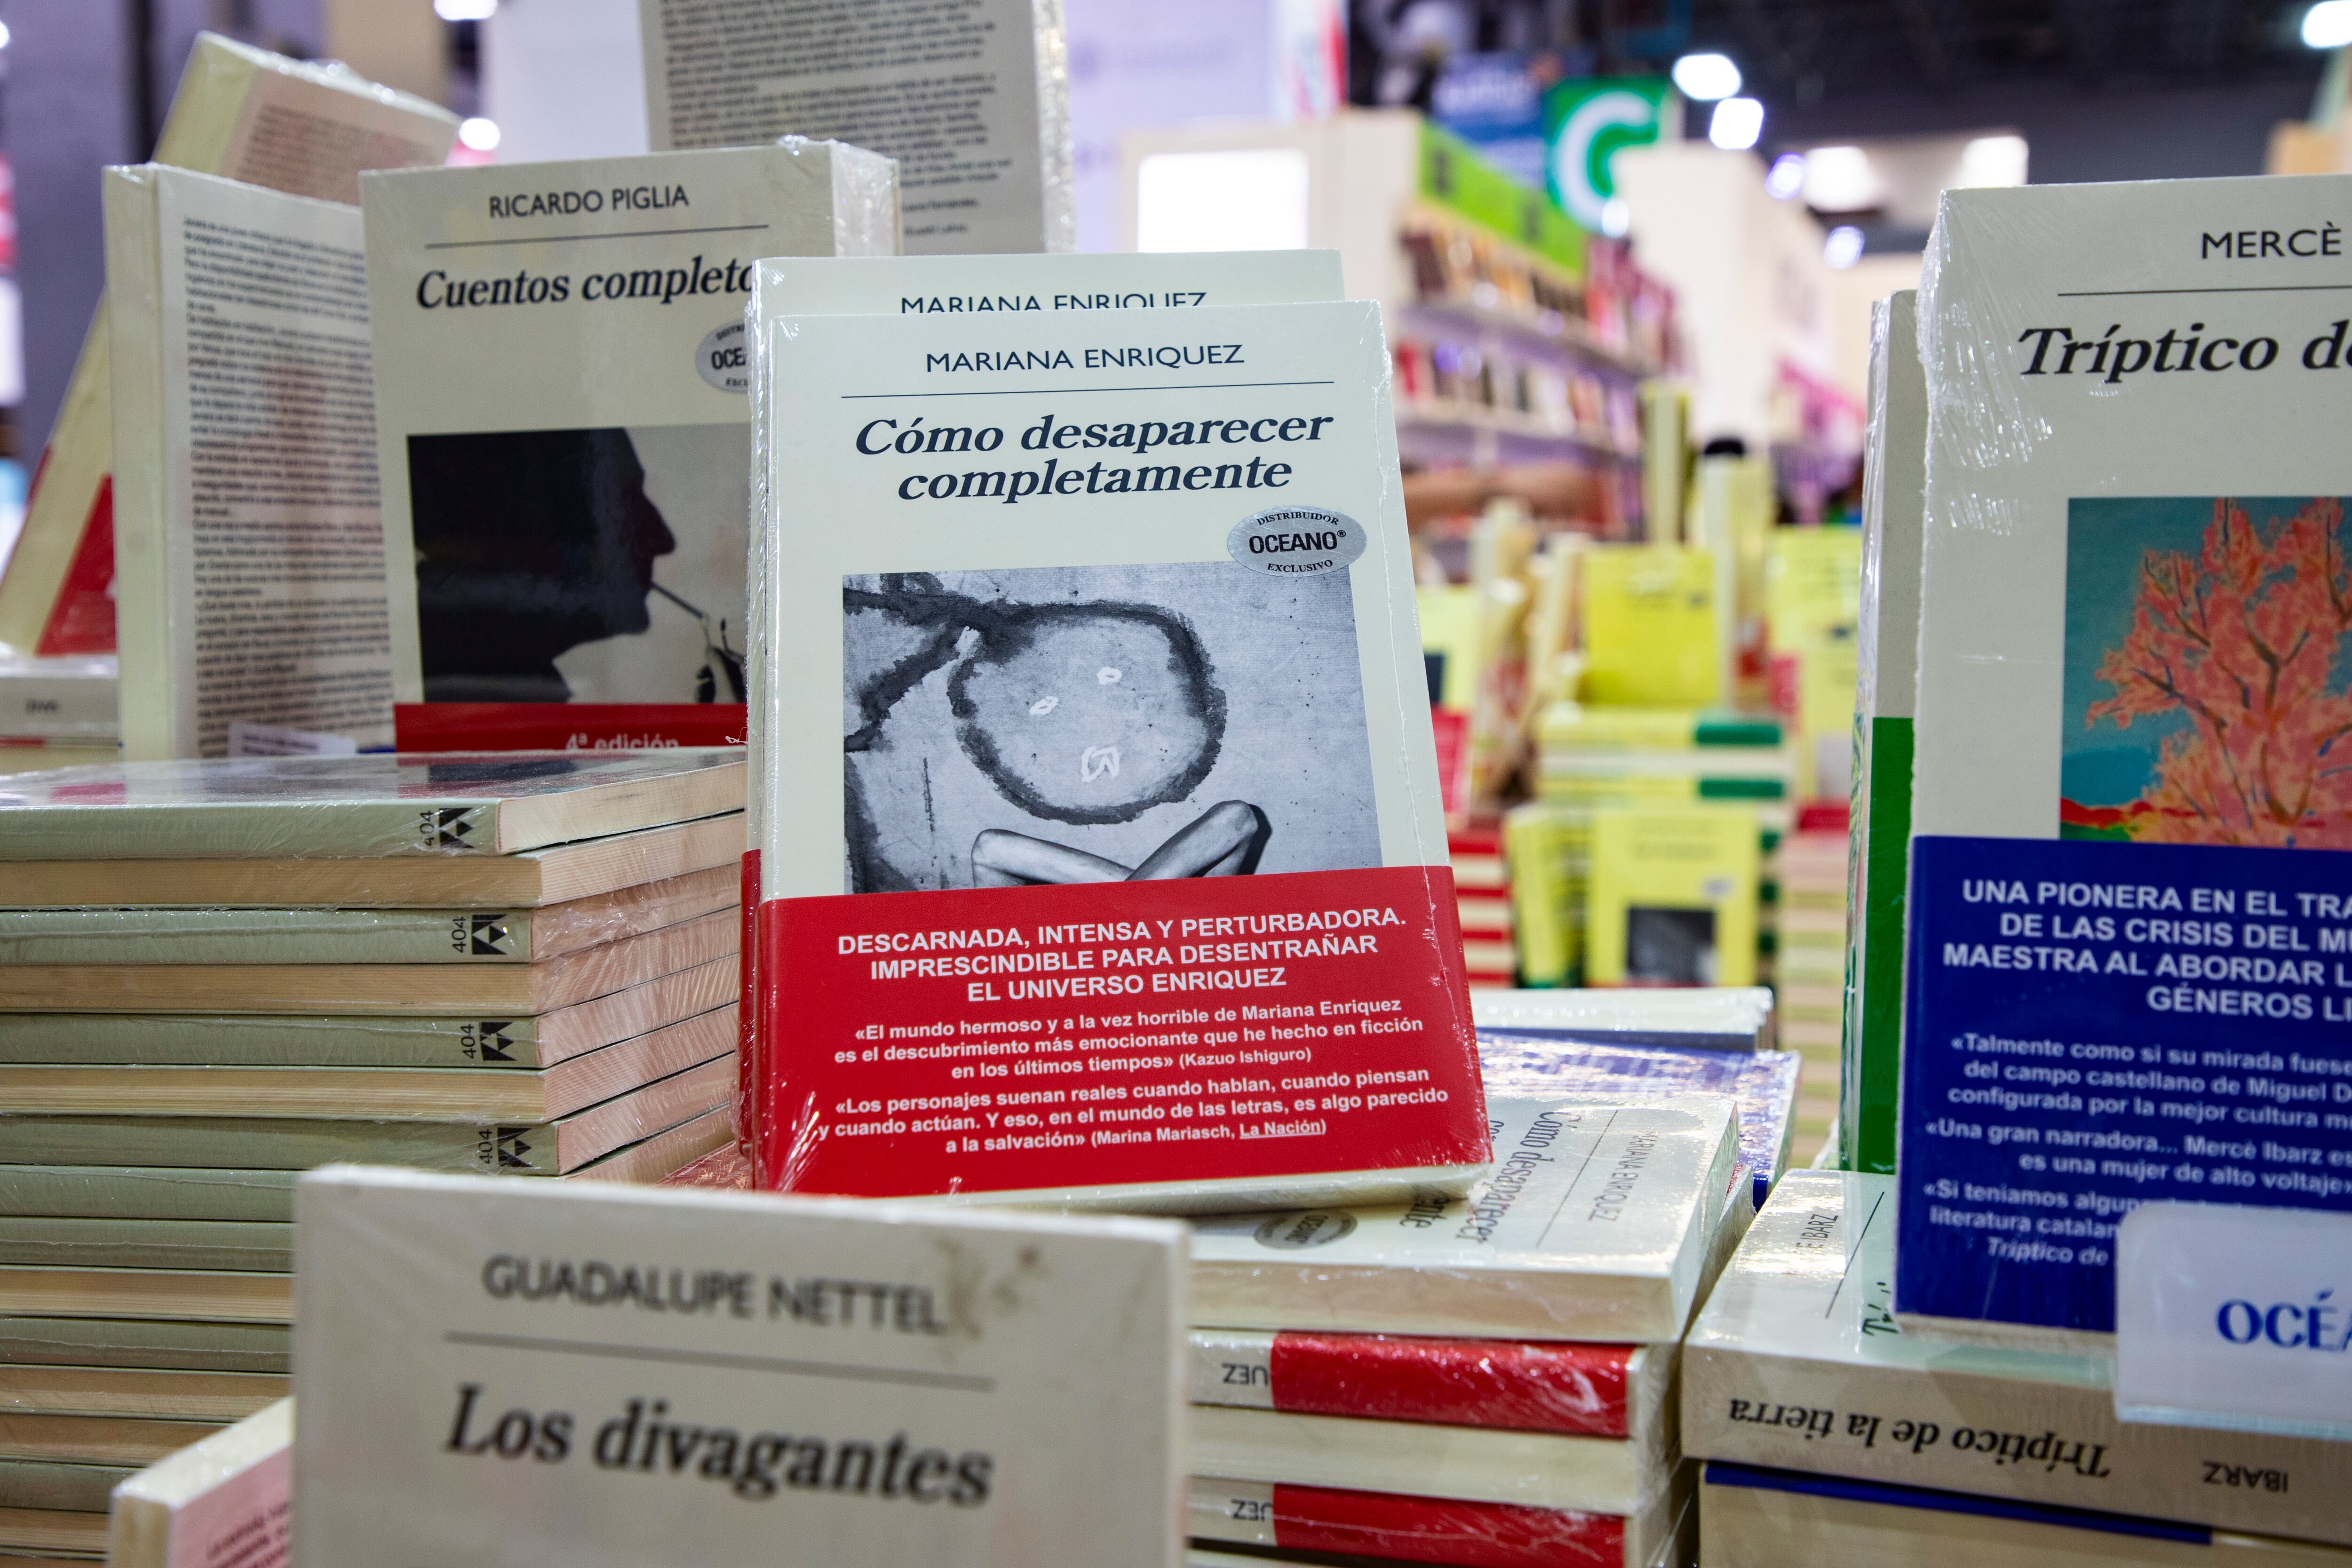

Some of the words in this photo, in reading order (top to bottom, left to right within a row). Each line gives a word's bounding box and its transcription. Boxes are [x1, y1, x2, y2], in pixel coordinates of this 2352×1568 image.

[489, 190, 604, 218] RICARDO
[612, 185, 689, 210] PIGLIA
[2201, 222, 2342, 259] MERCÈ
[416, 271, 569, 309] Cuentos
[581, 255, 752, 304] completo
[927, 350, 1074, 373] MARIANA
[1085, 344, 1245, 369] ENRIQUEZ
[2018, 322, 2280, 383] Tríptico
[856, 417, 1004, 455] Cómo
[1021, 414, 1334, 454] desaparecer
[898, 456, 1292, 504] completamente
[1256, 512, 1339, 525] DISTRIBUIDOR
[1267, 559, 1333, 572] EXCLUSIVO
[420, 810, 435, 847] 404
[1963, 879, 2029, 904] UNA
[2038, 882, 2182, 910] PIONERA
[2192, 888, 2235, 913] EN
[2246, 891, 2287, 915] EL
[452, 916, 466, 953] 404
[838, 928, 1030, 955] DESCARNADA,
[1038, 921, 1152, 945] INTENSA
[1156, 920, 1173, 938] Y
[1181, 907, 1406, 938] PERTURBADORA.
[2001, 913, 2042, 937] DE
[2053, 915, 2115, 941] LAS
[2125, 918, 2233, 947] CRISIS
[2244, 924, 2309, 950] DEL
[871, 944, 1094, 979] IMPRESCINDIBLE
[1102, 947, 1174, 968] PARA
[1180, 933, 1378, 964] DESENTRAÑAR
[1944, 943, 2098, 972] MAESTRA
[2105, 951, 2147, 975] AL
[2155, 954, 2324, 985] ABORDAR
[968, 982, 1001, 1002] EL
[1008, 974, 1144, 1000] UNIVERSO
[1152, 967, 1287, 992] ENRIQUEZ
[2147, 983, 2313, 1019] GÉNEROS
[855, 1025, 884, 1040] «El
[890, 1022, 954, 1038] mundo
[960, 1020, 1042, 1035] hermoso
[1047, 1019, 1058, 1034] y
[1063, 1018, 1074, 1030] a
[1080, 1014, 1096, 1029] la
[1100, 1015, 1133, 1027] vez
[1137, 1009, 1209, 1026] horrible
[1214, 1007, 1237, 1022] de
[1242, 1004, 1315, 1020] Mariana
[1319, 999, 1402, 1016] Enriquez
[461, 1024, 475, 1059] 404
[834, 1051, 857, 1063] es
[862, 1046, 878, 1062] el
[884, 1040, 1030, 1060] descubrimiento
[1035, 1036, 1074, 1052] más
[1079, 1031, 1199, 1051] emocionante
[1203, 1031, 1238, 1047] que
[1243, 1027, 1266, 1042] he
[1271, 1024, 1328, 1040] hecho
[1333, 1024, 1356, 1036] en
[1360, 1017, 1423, 1034] ficción
[2070, 1043, 2135, 1061] como
[2141, 1046, 2161, 1062] si
[2168, 1050, 2196, 1065] su
[2202, 1051, 2284, 1070] mirada
[951, 1066, 974, 1079] en
[980, 1062, 1009, 1077] los
[1014, 1059, 1083, 1075] últimos
[1088, 1056, 1174, 1073] tiempos»
[1179, 1053, 1236, 1070] (Kazuo
[1240, 1047, 1311, 1065] Ishiguro)
[1964, 1060, 1998, 1078] del
[2004, 1066, 2081, 1086] campo
[2086, 1071, 2205, 1092] castellano
[2211, 1076, 2241, 1094] de
[2247, 1077, 2326, 1102] Miguel
[835, 1098, 882, 1114] «Los
[887, 1092, 991, 1115] personajes
[996, 1090, 1065, 1106] suenan
[1071, 1085, 1128, 1101] reales
[1132, 1080, 1202, 1098] cuando
[1208, 1077, 1276, 1094] hablan,
[1281, 1072, 1351, 1090] cuando
[1356, 1069, 1429, 1089] piensan
[1948, 1086, 2082, 1111] configurada
[2089, 1098, 2128, 1116] por
[2134, 1097, 2154, 1115] la
[2161, 1102, 2227, 1124] mejor
[2234, 1106, 2318, 1127] cultura
[818, 1125, 830, 1141] y
[835, 1118, 906, 1137] cuando
[911, 1115, 980, 1132] actúan.
[985, 1112, 999, 1128] Y
[1004, 1114, 1043, 1128] eso,
[1049, 1112, 1072, 1125] en
[1077, 1107, 1094, 1123] el
[1099, 1104, 1165, 1122] mundo
[1170, 1103, 1193, 1118] de
[1199, 1101, 1226, 1117] las
[1231, 1099, 1289, 1115] letras,
[1294, 1098, 1316, 1111] es
[1321, 1094, 1362, 1112] algo
[1367, 1087, 1448, 1110] parecido
[1521, 1112, 1582, 1149] Cómo
[478, 1129, 493, 1164] 404
[946, 1140, 957, 1154] a
[962, 1137, 979, 1152] la
[984, 1131, 1086, 1151] salvación»
[1091, 1130, 1152, 1148] (Marina
[1156, 1124, 1235, 1141] Mariasch,
[1240, 1123, 1262, 1138] La
[1265, 1118, 1327, 1136] Nación)
[1615, 1131, 1660, 1170] MARIANA
[1926, 1118, 1982, 1139] «Una
[1988, 1123, 2039, 1145] gran
[2263, 1142, 2322, 1164] Ibarz
[2019, 1154, 2047, 1170] es
[2052, 1158, 2096, 1174] una
[2101, 1161, 2169, 1183] mujer
[2174, 1163, 2204, 1182] de
[2210, 1166, 2256, 1186] alto
[1456, 1151, 1556, 1243] desaparecer
[1588, 1171, 1639, 1222] ENRIQUEZ
[1800, 1214, 1838, 1241] IBARZ
[1930, 1205, 2031, 1232] literatura
[2078, 1246, 2109, 1266] de
[484, 1255, 754, 1318] GUADALUPE
[769, 1278, 951, 1336] NETTEL
[1729, 1398, 1834, 1441] tierra
[1847, 1412, 1883, 1449] la
[1893, 1419, 1940, 1454] de
[446, 1385, 573, 1462] Los
[593, 1400, 992, 1505] divagantes
[1952, 1426, 2110, 1478] Tríptico
[2203, 1460, 2288, 1493] IBARZ
